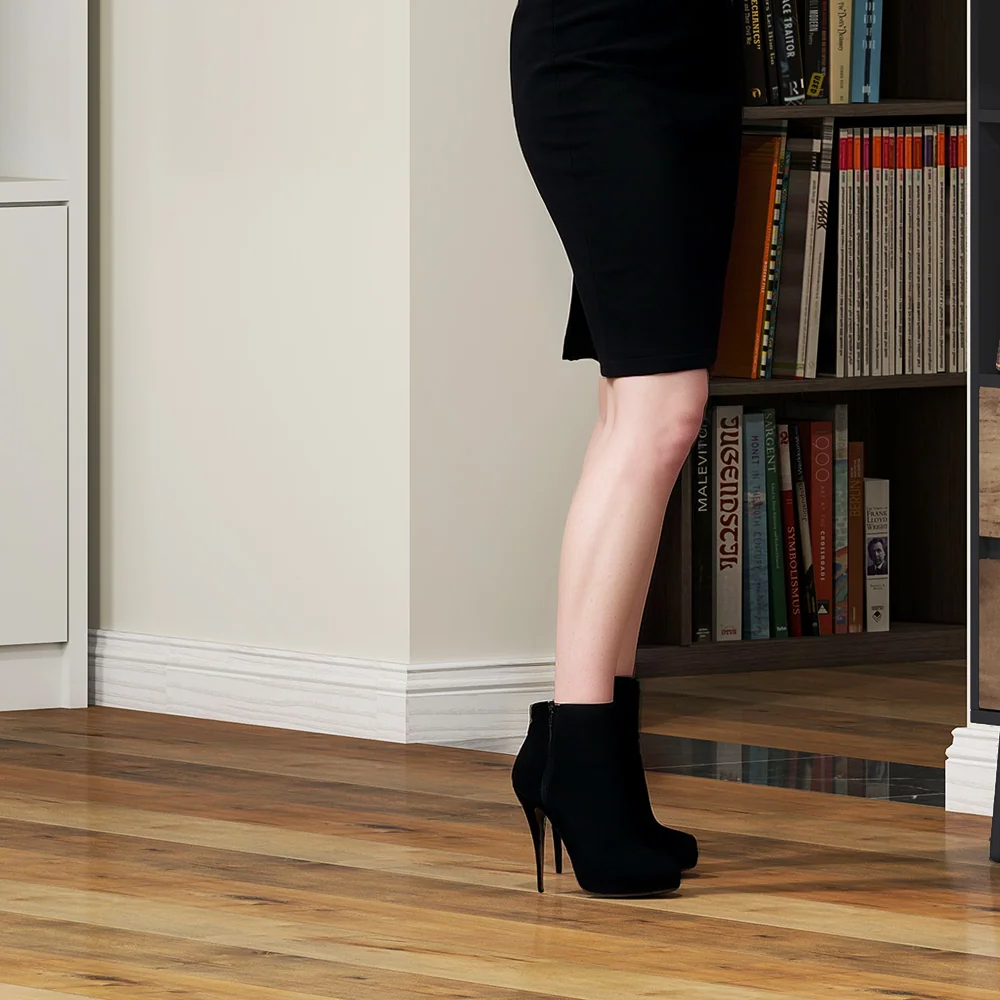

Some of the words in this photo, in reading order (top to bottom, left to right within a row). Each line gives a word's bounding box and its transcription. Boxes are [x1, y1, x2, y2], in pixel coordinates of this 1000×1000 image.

[809, 9, 819, 32] MODERN
[783, 16, 796, 58] TRAITOR
[810, 75, 822, 94] USED
[751, 435, 760, 465] MONET
[764, 412, 776, 473] SARGENT
[779, 431, 789, 445] 2
[752, 470, 760, 480] IN
[719, 415, 739, 571] JUGENDSTIL
[752, 486, 761, 500] THE
[849, 480, 861, 517] BERLIN
[752, 504, 762, 526] 20TH
[753, 532, 763, 569] CENTURY
[787, 525, 801, 616] SYMBOLISMUS
